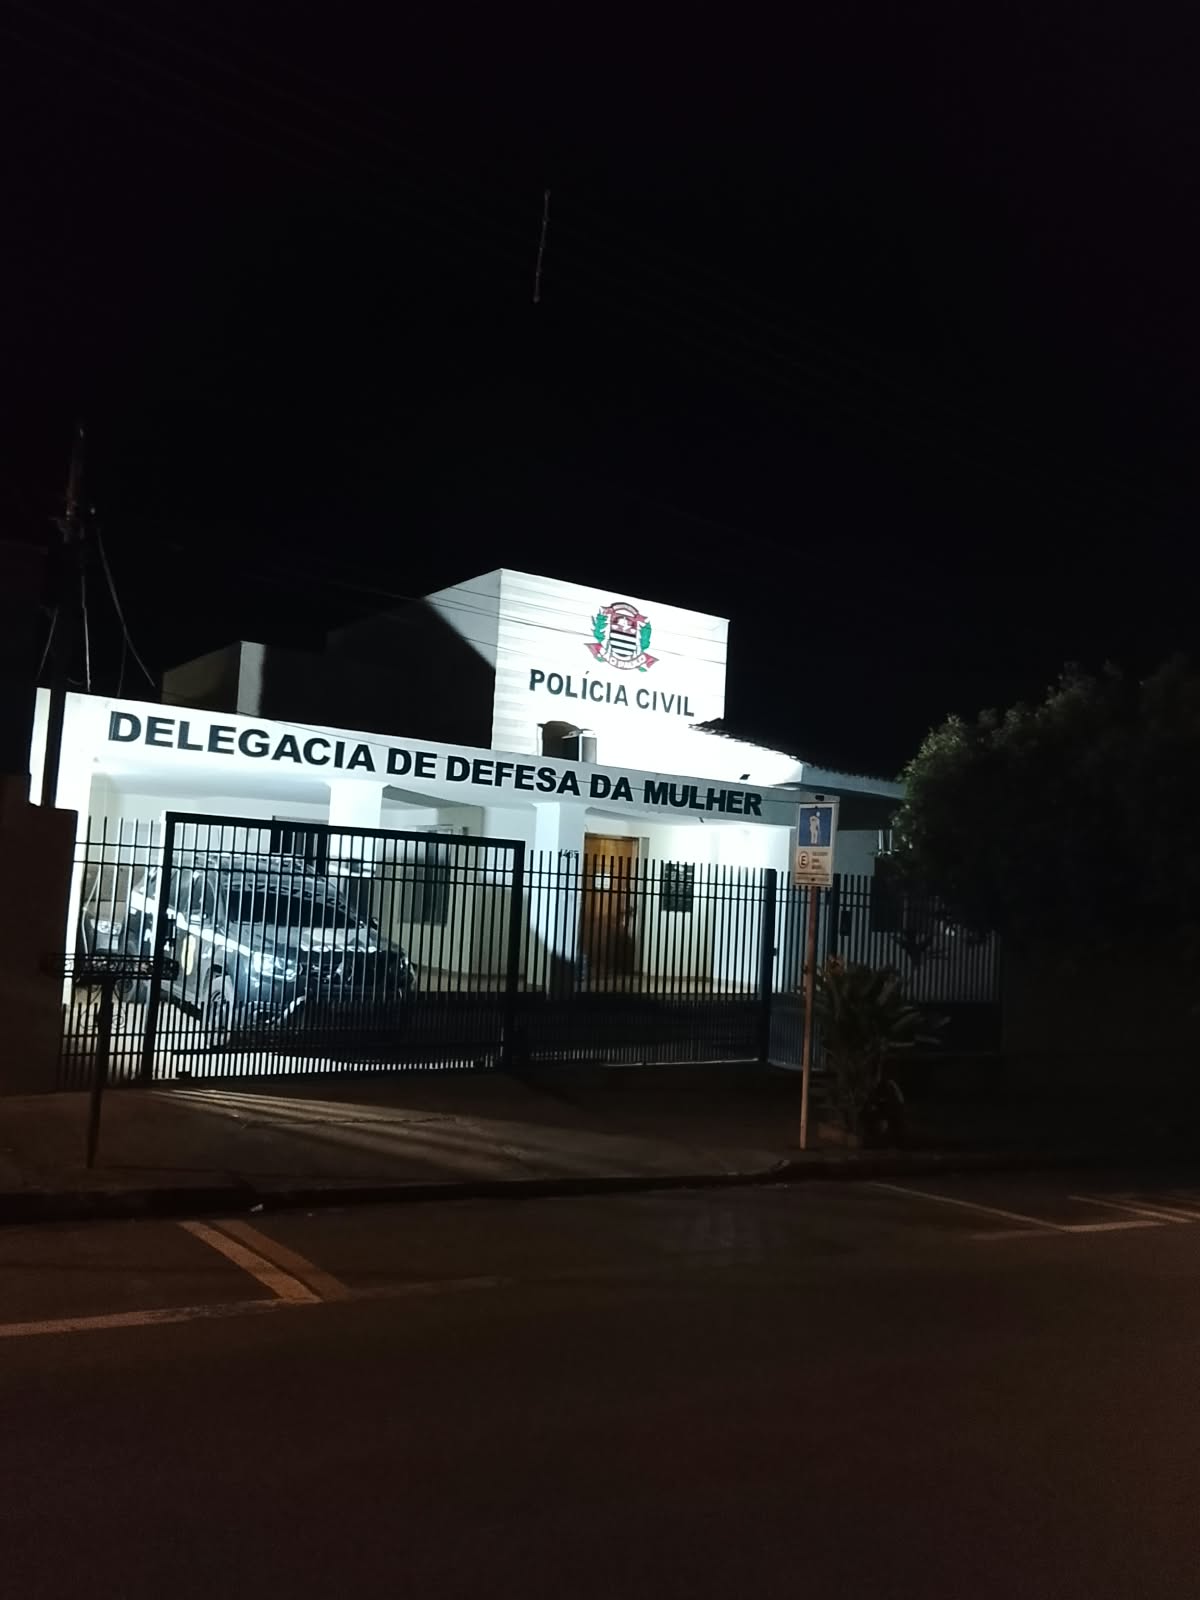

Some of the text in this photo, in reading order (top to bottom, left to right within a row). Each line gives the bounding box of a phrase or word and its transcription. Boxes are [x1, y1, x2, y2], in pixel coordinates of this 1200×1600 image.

[529, 668, 695, 717] POLÍCIA CIVIL
[108, 710, 763, 817] DELEGACIA DE DEFESA DA MULHER
